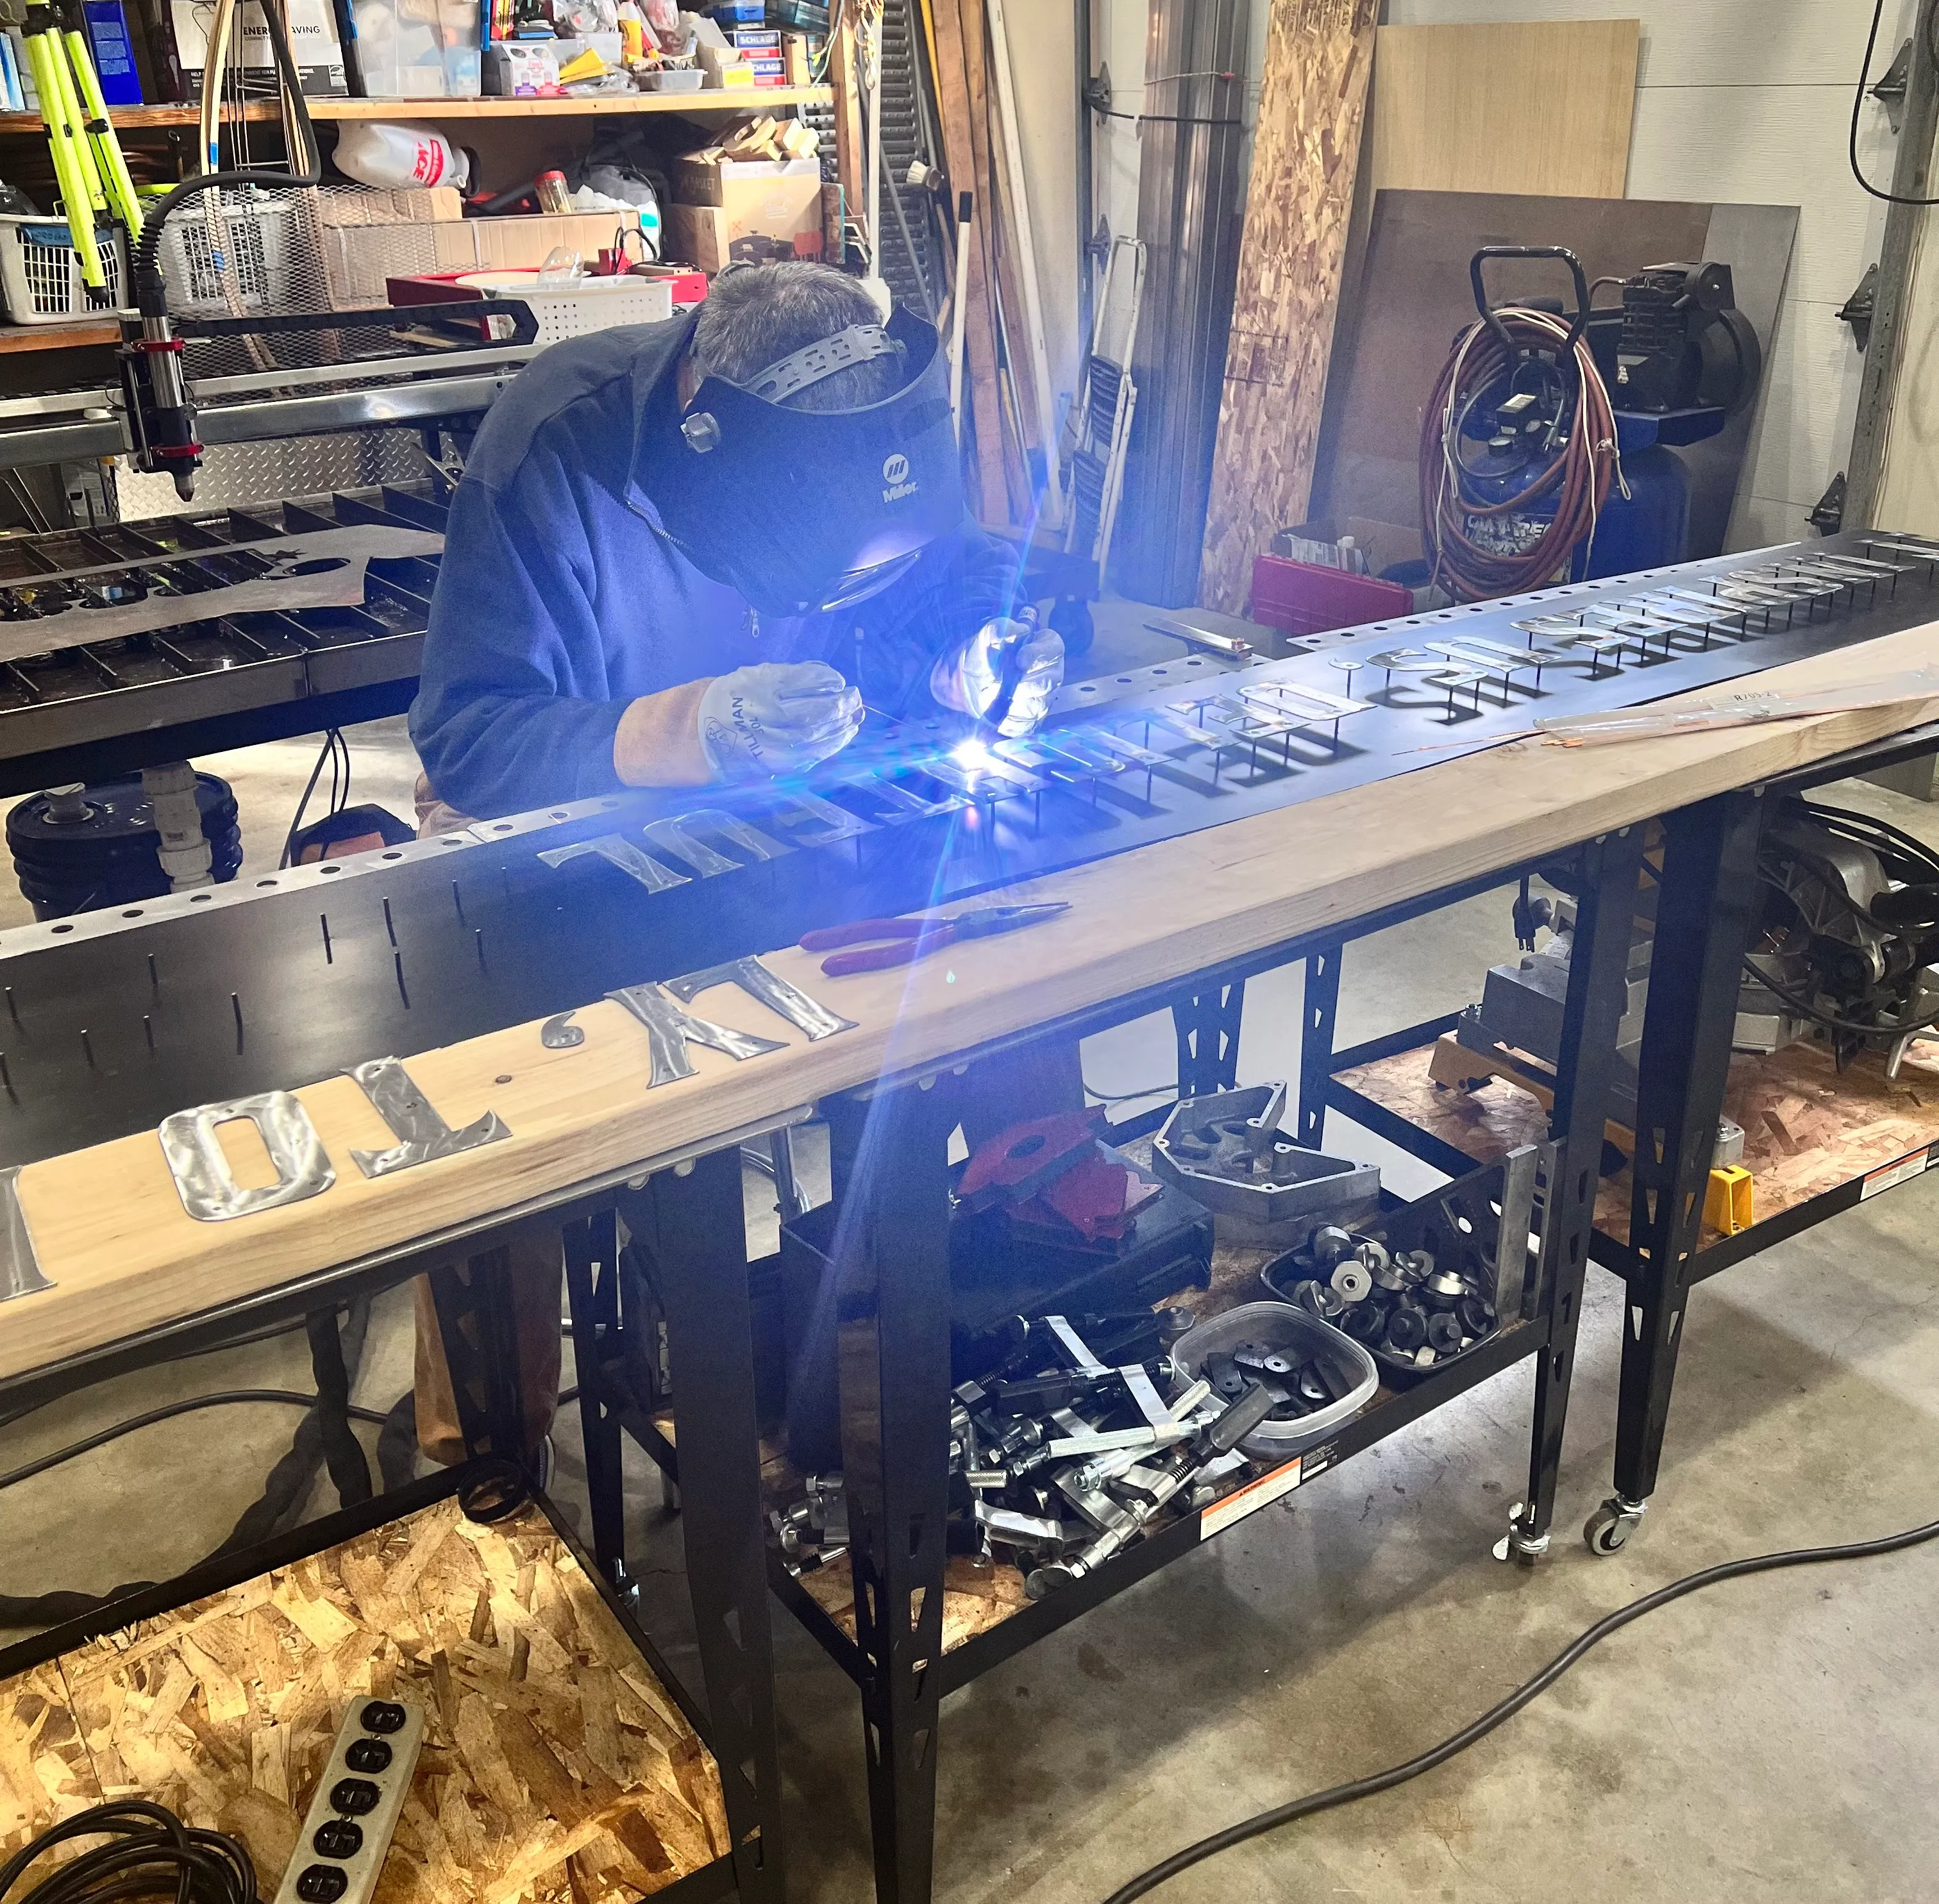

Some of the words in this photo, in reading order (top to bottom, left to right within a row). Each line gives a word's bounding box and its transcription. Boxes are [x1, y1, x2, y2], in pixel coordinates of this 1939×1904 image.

[243, 26, 268, 35] ENER
[291, 26, 321, 34] AVING
[754, 63, 781, 72] CHLAGE
[732, 697, 764, 760] TILLMAN
